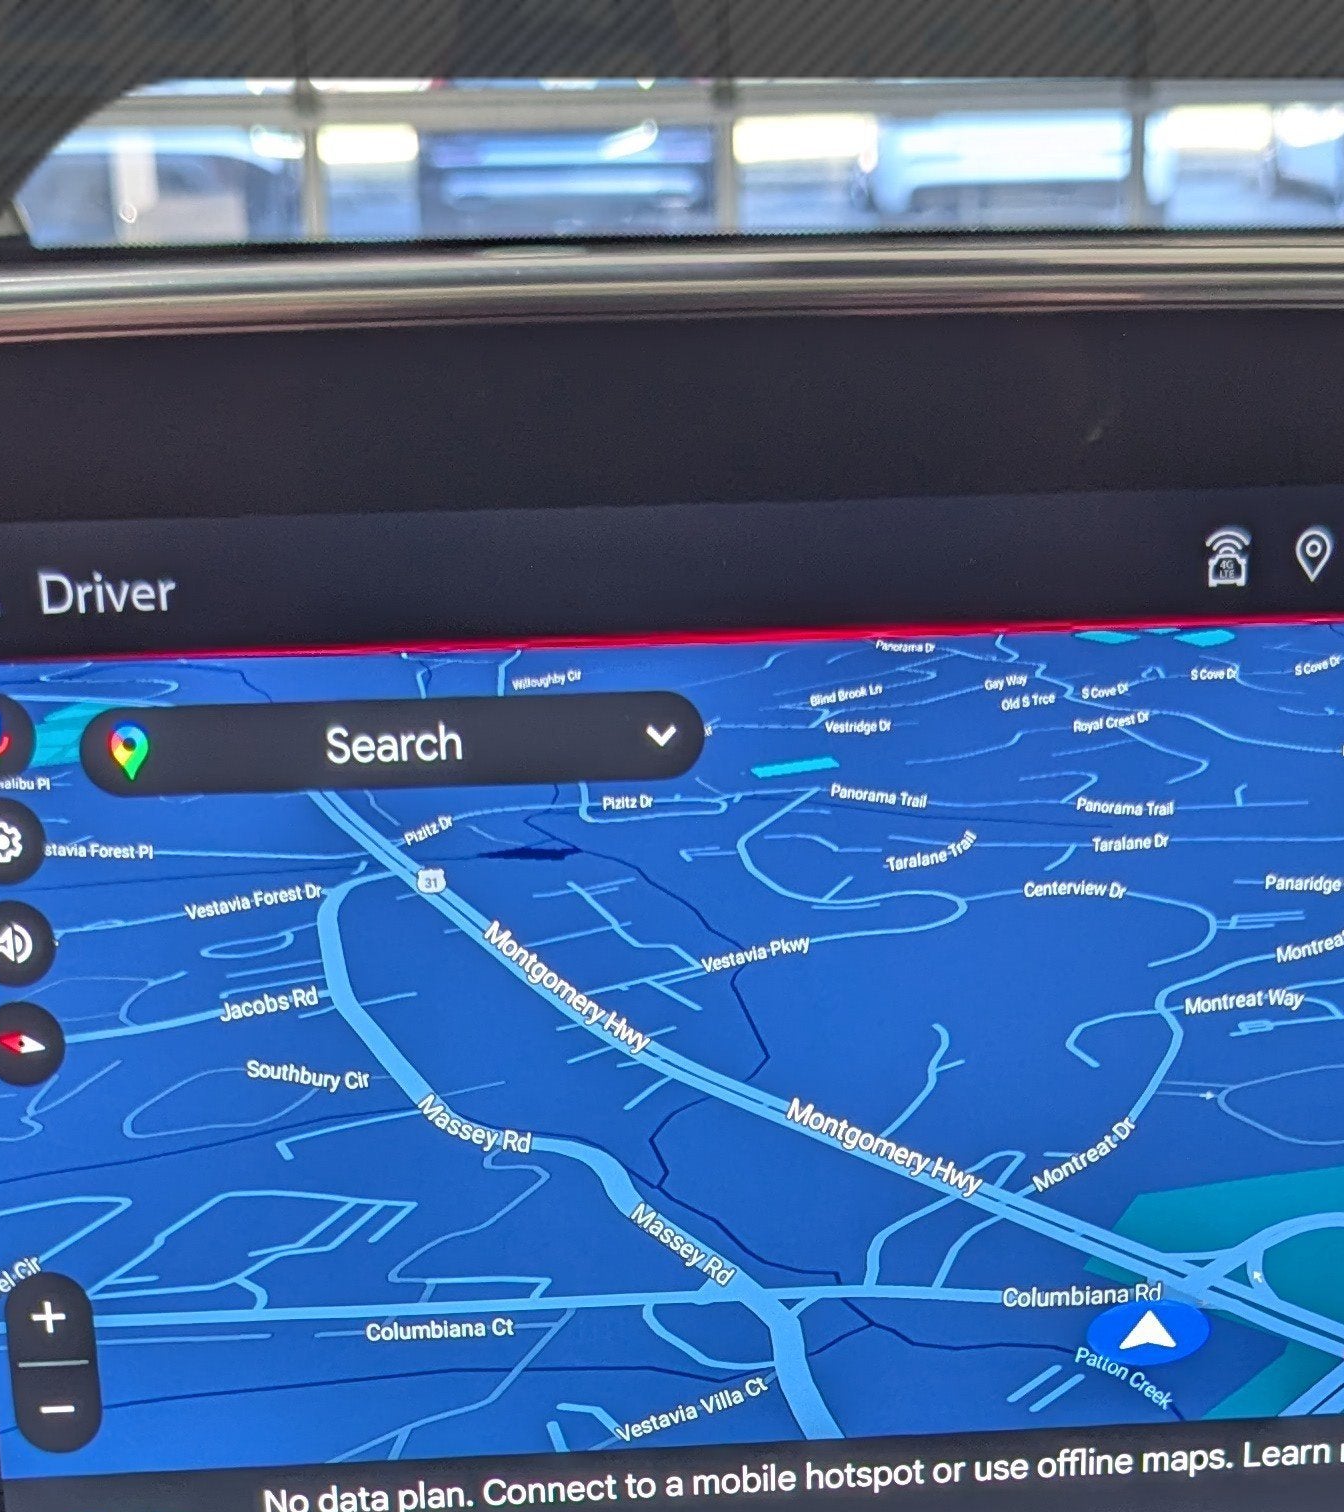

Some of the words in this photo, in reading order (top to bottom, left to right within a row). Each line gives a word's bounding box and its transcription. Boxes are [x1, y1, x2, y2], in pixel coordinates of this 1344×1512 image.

[38, 570, 176, 614] Driver
[925, 642, 936, 653] Dr
[1190, 669, 1197, 681] S
[1199, 668, 1225, 680] Cove
[1226, 668, 1237, 680] Dr
[1295, 665, 1302, 676] S
[1303, 660, 1329, 674] Cove
[1329, 655, 1341, 668] Dr
[838, 685, 867, 702] Brook
[869, 683, 883, 696] Ln
[984, 679, 1004, 691] Gay
[1006, 674, 1027, 687] Way
[1081, 687, 1090, 700] S
[1091, 686, 1117, 699] Cove
[1118, 682, 1129, 695] Dr
[1001, 695, 1020, 711] Old
[825, 720, 877, 735] Vestridge
[879, 718, 891, 732] Dr
[1073, 717, 1103, 734] Royal
[1106, 714, 1135, 729] Crest
[1137, 710, 1150, 724] Dr
[326, 719, 463, 764] Search
[37, 778, 51, 790] Pl
[830, 783, 896, 806] Panorama
[899, 790, 928, 809] Trail
[603, 794, 638, 811] Pizitz
[639, 794, 654, 809] Dr
[1076, 797, 1143, 816] Panorama
[1145, 799, 1174, 816] Trail
[404, 818, 439, 847] Pizitz
[437, 813, 454, 832] Dr
[90, 843, 135, 859] Forest
[139, 844, 154, 860] Pl
[886, 851, 947, 872] Taralane
[946, 829, 978, 859] Trail
[1092, 835, 1151, 854] Taralane
[1154, 833, 1170, 849] Dr
[425, 876, 439, 889] 31
[1023, 880, 1106, 898] Centerview
[1108, 881, 1127, 899] Dr
[1264, 874, 1341, 894] Panaridge
[183, 896, 251, 920] Vestavia
[253, 888, 303, 910] Forest
[305, 883, 322, 899] Dr
[701, 946, 767, 973] Vestavia
[769, 937, 811, 957] Pkwy
[484, 920, 605, 1025] Montgomery
[603, 1011, 651, 1054] Hwy
[219, 990, 290, 1022] Jacobs
[291, 986, 319, 1008] Rd
[1184, 992, 1265, 1014] Montreat
[1267, 988, 1305, 1011] Way
[246, 1059, 341, 1093] Southbury
[344, 1069, 370, 1090] Cir
[417, 1093, 499, 1150] Massey
[504, 1128, 532, 1154] Rd
[786, 1097, 932, 1176] Montgomery
[931, 1155, 983, 1198] Hwy
[1032, 1135, 1118, 1193] Montreat
[1112, 1115, 1136, 1142] Dr
[630, 1202, 706, 1269] Massey
[702, 1252, 736, 1286] Rd
[14, 1257, 42, 1280] Cir
[1003, 1286, 1130, 1308] Columbiana
[1134, 1282, 1163, 1303] Rd
[365, 1319, 486, 1342] Columbiana
[491, 1317, 515, 1337] Ct
[1074, 1346, 1129, 1381] Patton
[1129, 1371, 1173, 1411] Creek
[615, 1404, 699, 1442] Vestavia
[699, 1389, 745, 1415] Villa
[744, 1376, 769, 1397] Ct
[483, 1474, 618, 1507] Connect
[625, 1471, 657, 1499] to
[665, 1475, 684, 1497] a
[693, 1463, 796, 1497] mobile
[805, 1458, 926, 1494] hotspot
[932, 1461, 966, 1484] or
[974, 1458, 1029, 1482] use
[1037, 1447, 1133, 1479] offline
[1142, 1448, 1233, 1477] maps.
[1243, 1441, 1331, 1468] Learn
